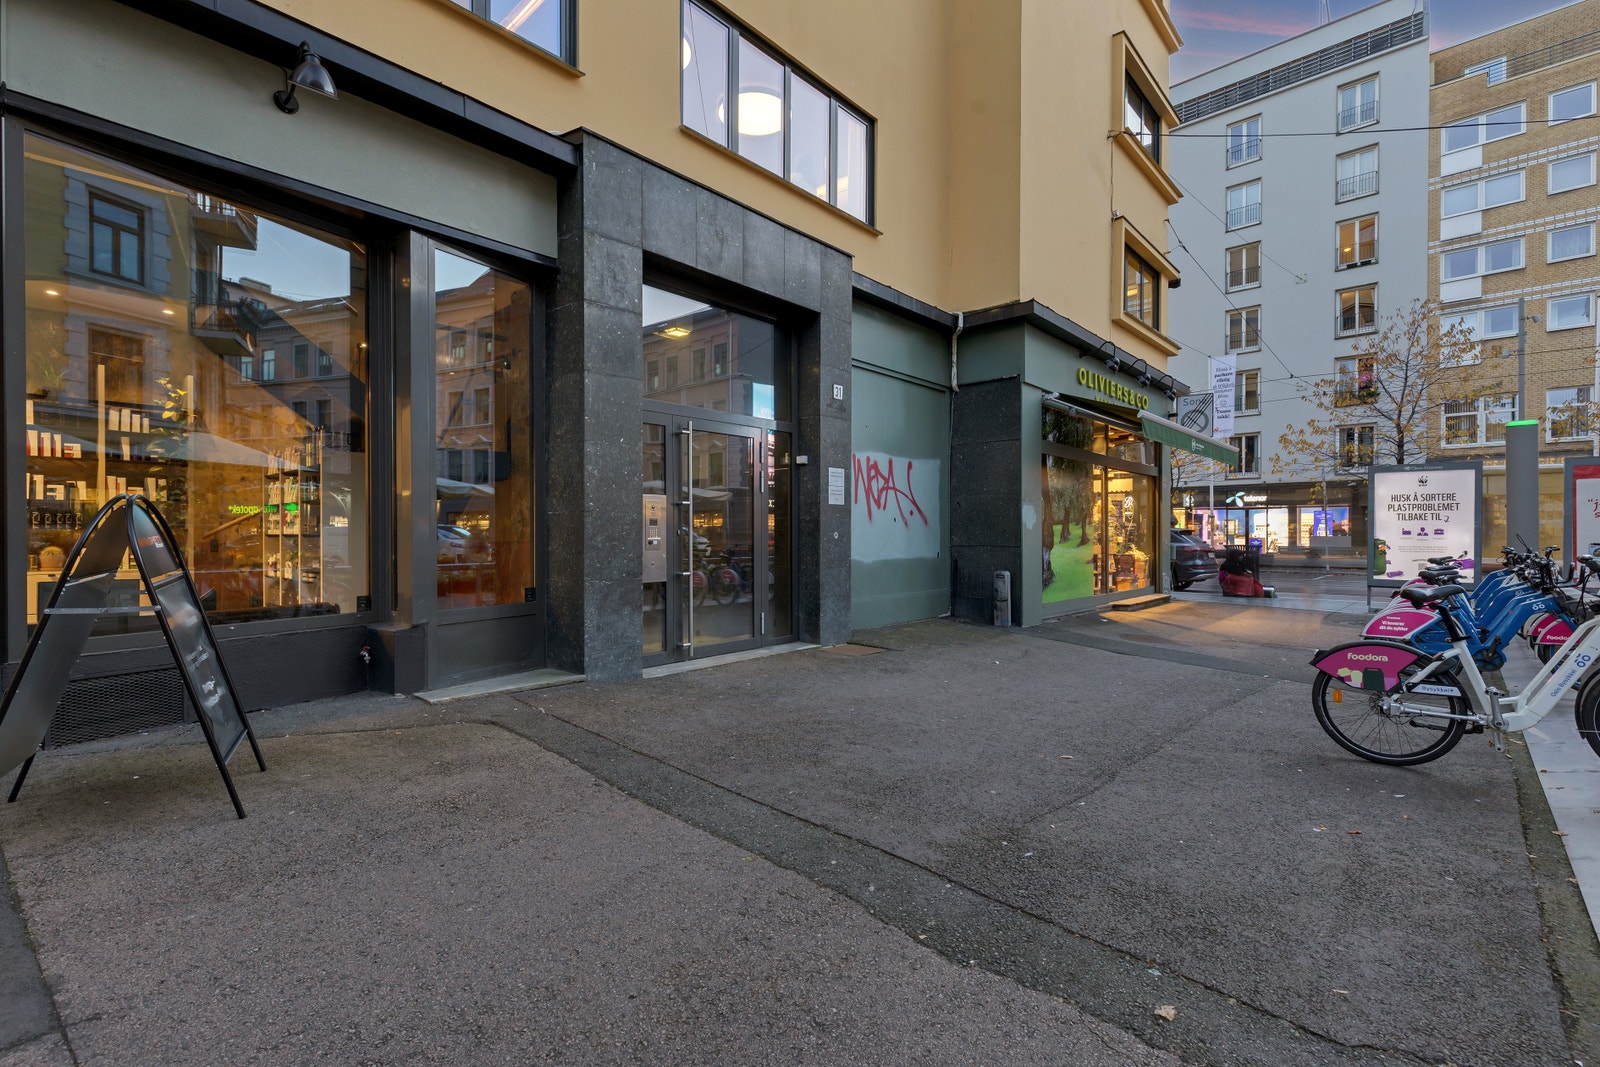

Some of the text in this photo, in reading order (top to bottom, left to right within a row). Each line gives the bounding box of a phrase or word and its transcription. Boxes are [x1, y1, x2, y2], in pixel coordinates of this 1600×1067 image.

[835, 386, 842, 398] 31
[1078, 367, 1148, 410] OLIVIERS&CO
[1391, 492, 1456, 502] HUSK Å SORTERE
[1388, 503, 1460, 512] PLASTPROBLEMET
[1347, 652, 1388, 662] foodora
